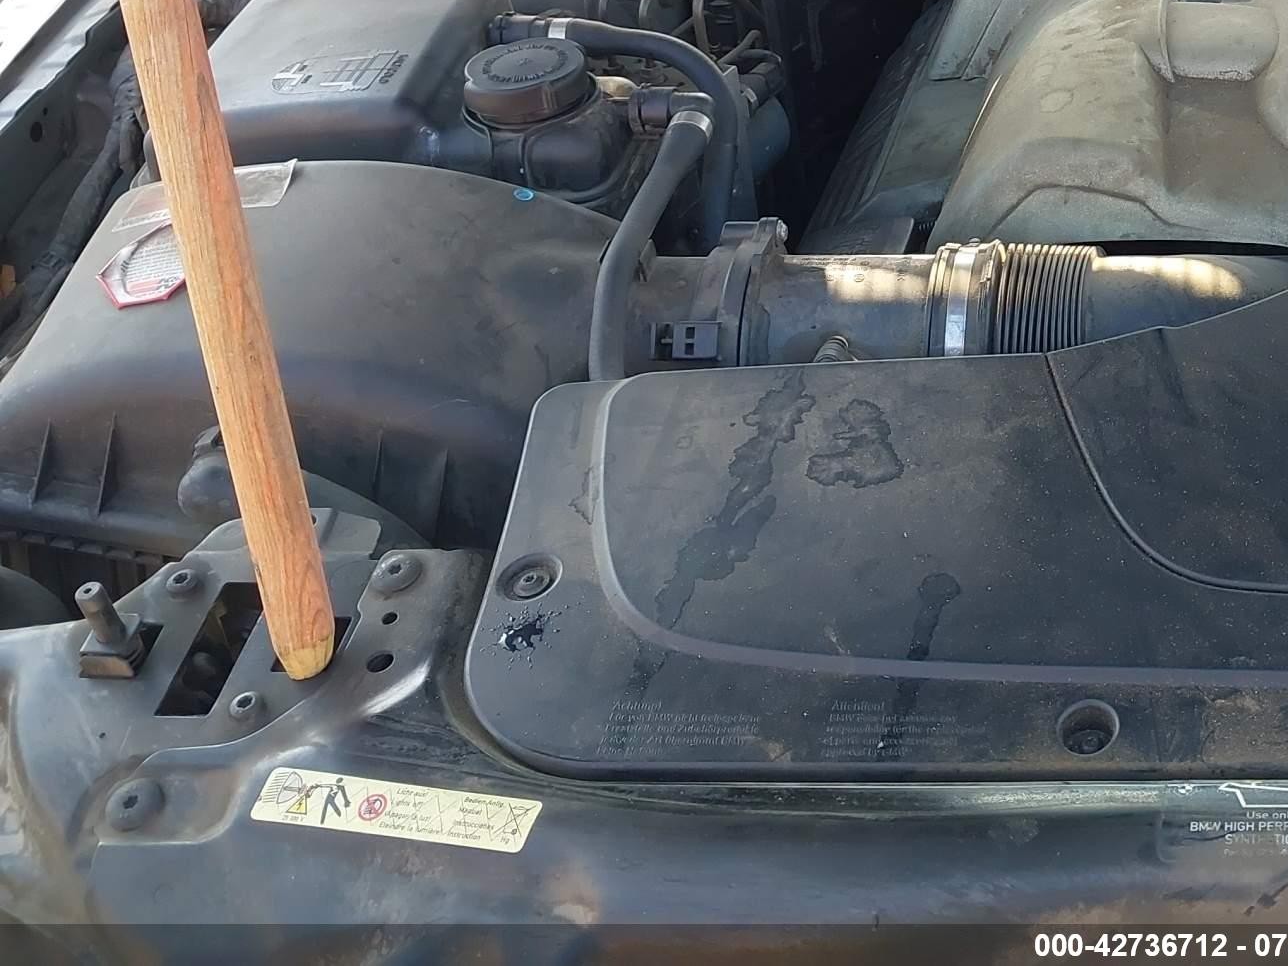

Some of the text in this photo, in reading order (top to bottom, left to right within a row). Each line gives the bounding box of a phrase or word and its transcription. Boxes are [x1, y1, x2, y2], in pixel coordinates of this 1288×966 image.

[1246, 811, 1269, 819] Use
[1190, 821, 1221, 832] BMW
[1224, 821, 1255, 832] HIGH
